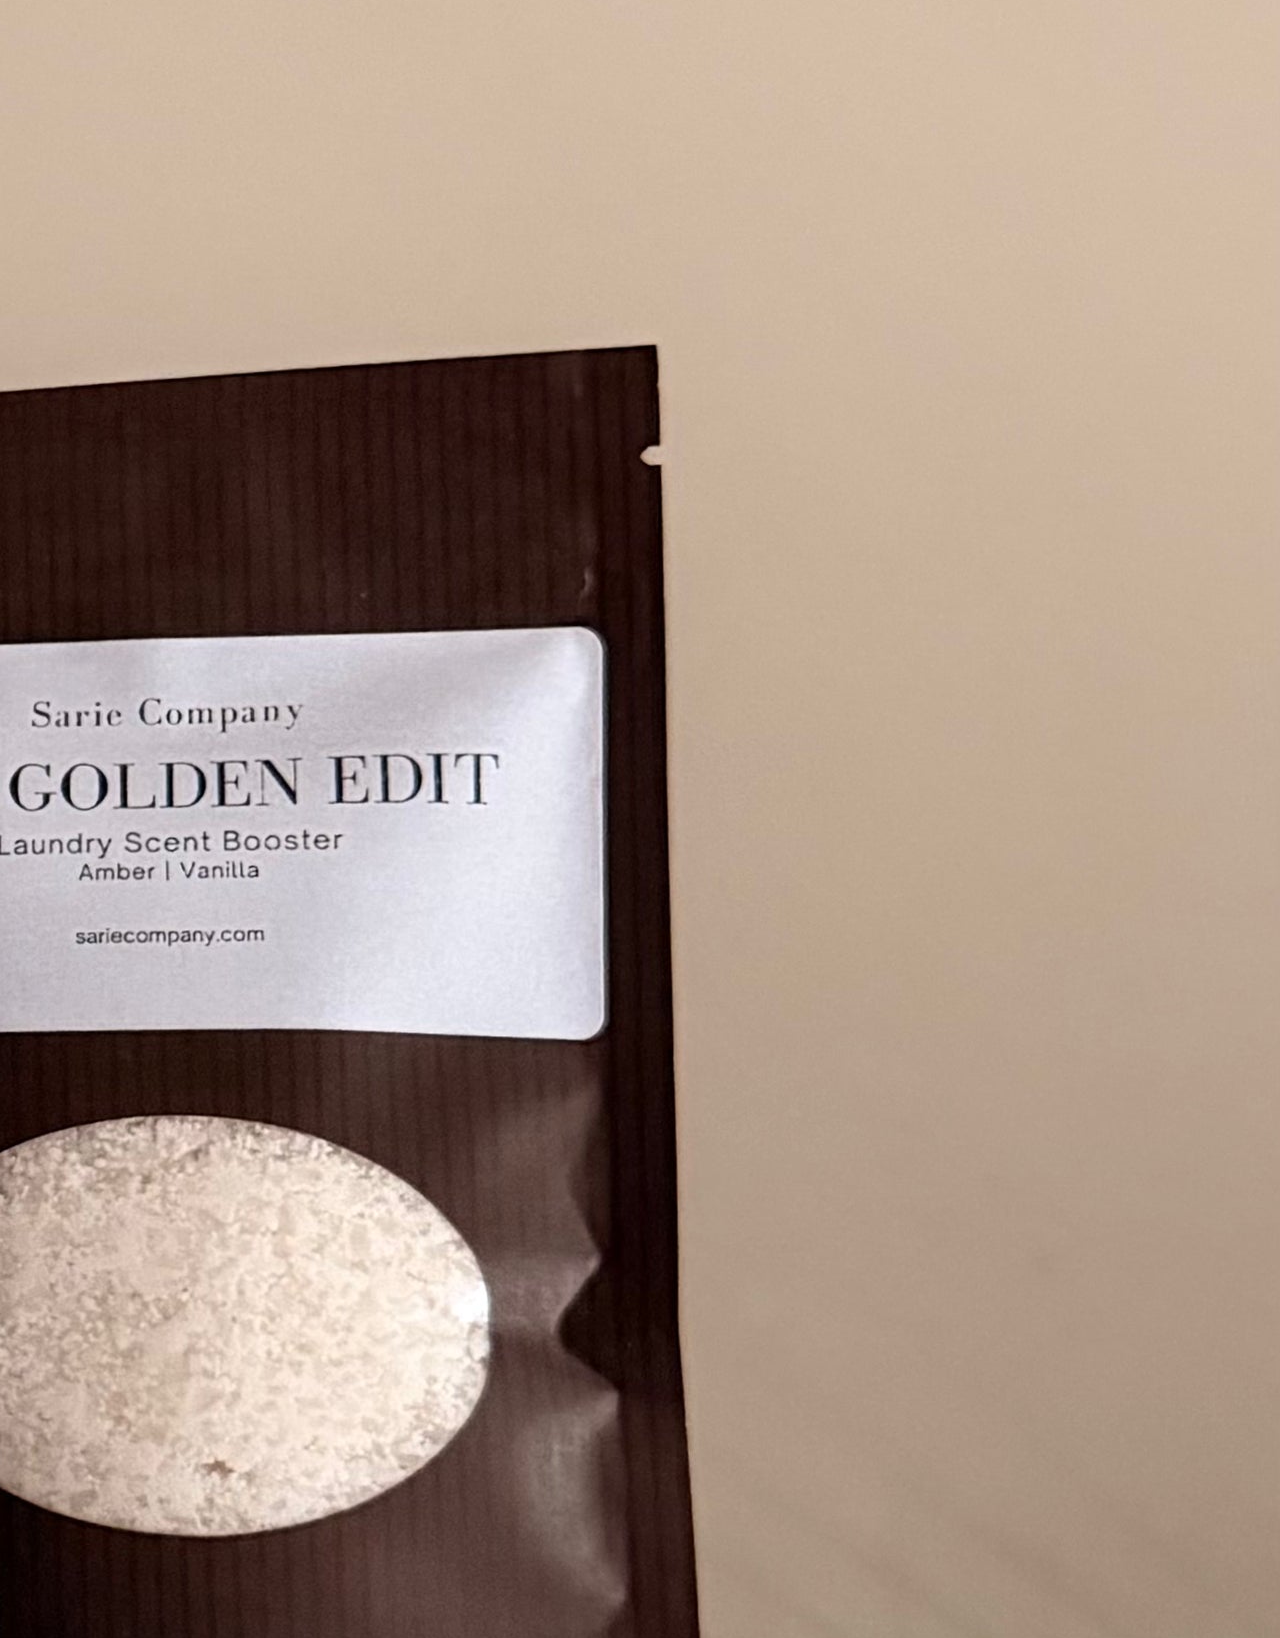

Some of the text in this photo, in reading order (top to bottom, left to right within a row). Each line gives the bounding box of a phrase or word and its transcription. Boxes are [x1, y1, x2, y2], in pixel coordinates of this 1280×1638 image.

[31, 698, 303, 734] Sarie Company
[8, 757, 302, 812] GOLDEN
[327, 752, 499, 805] EDIT
[124, 830, 211, 854] Scent
[223, 829, 344, 852] Booster
[78, 861, 156, 881] Amber
[179, 860, 260, 879] Vanilla
[75, 927, 265, 947] sariecompany.com
